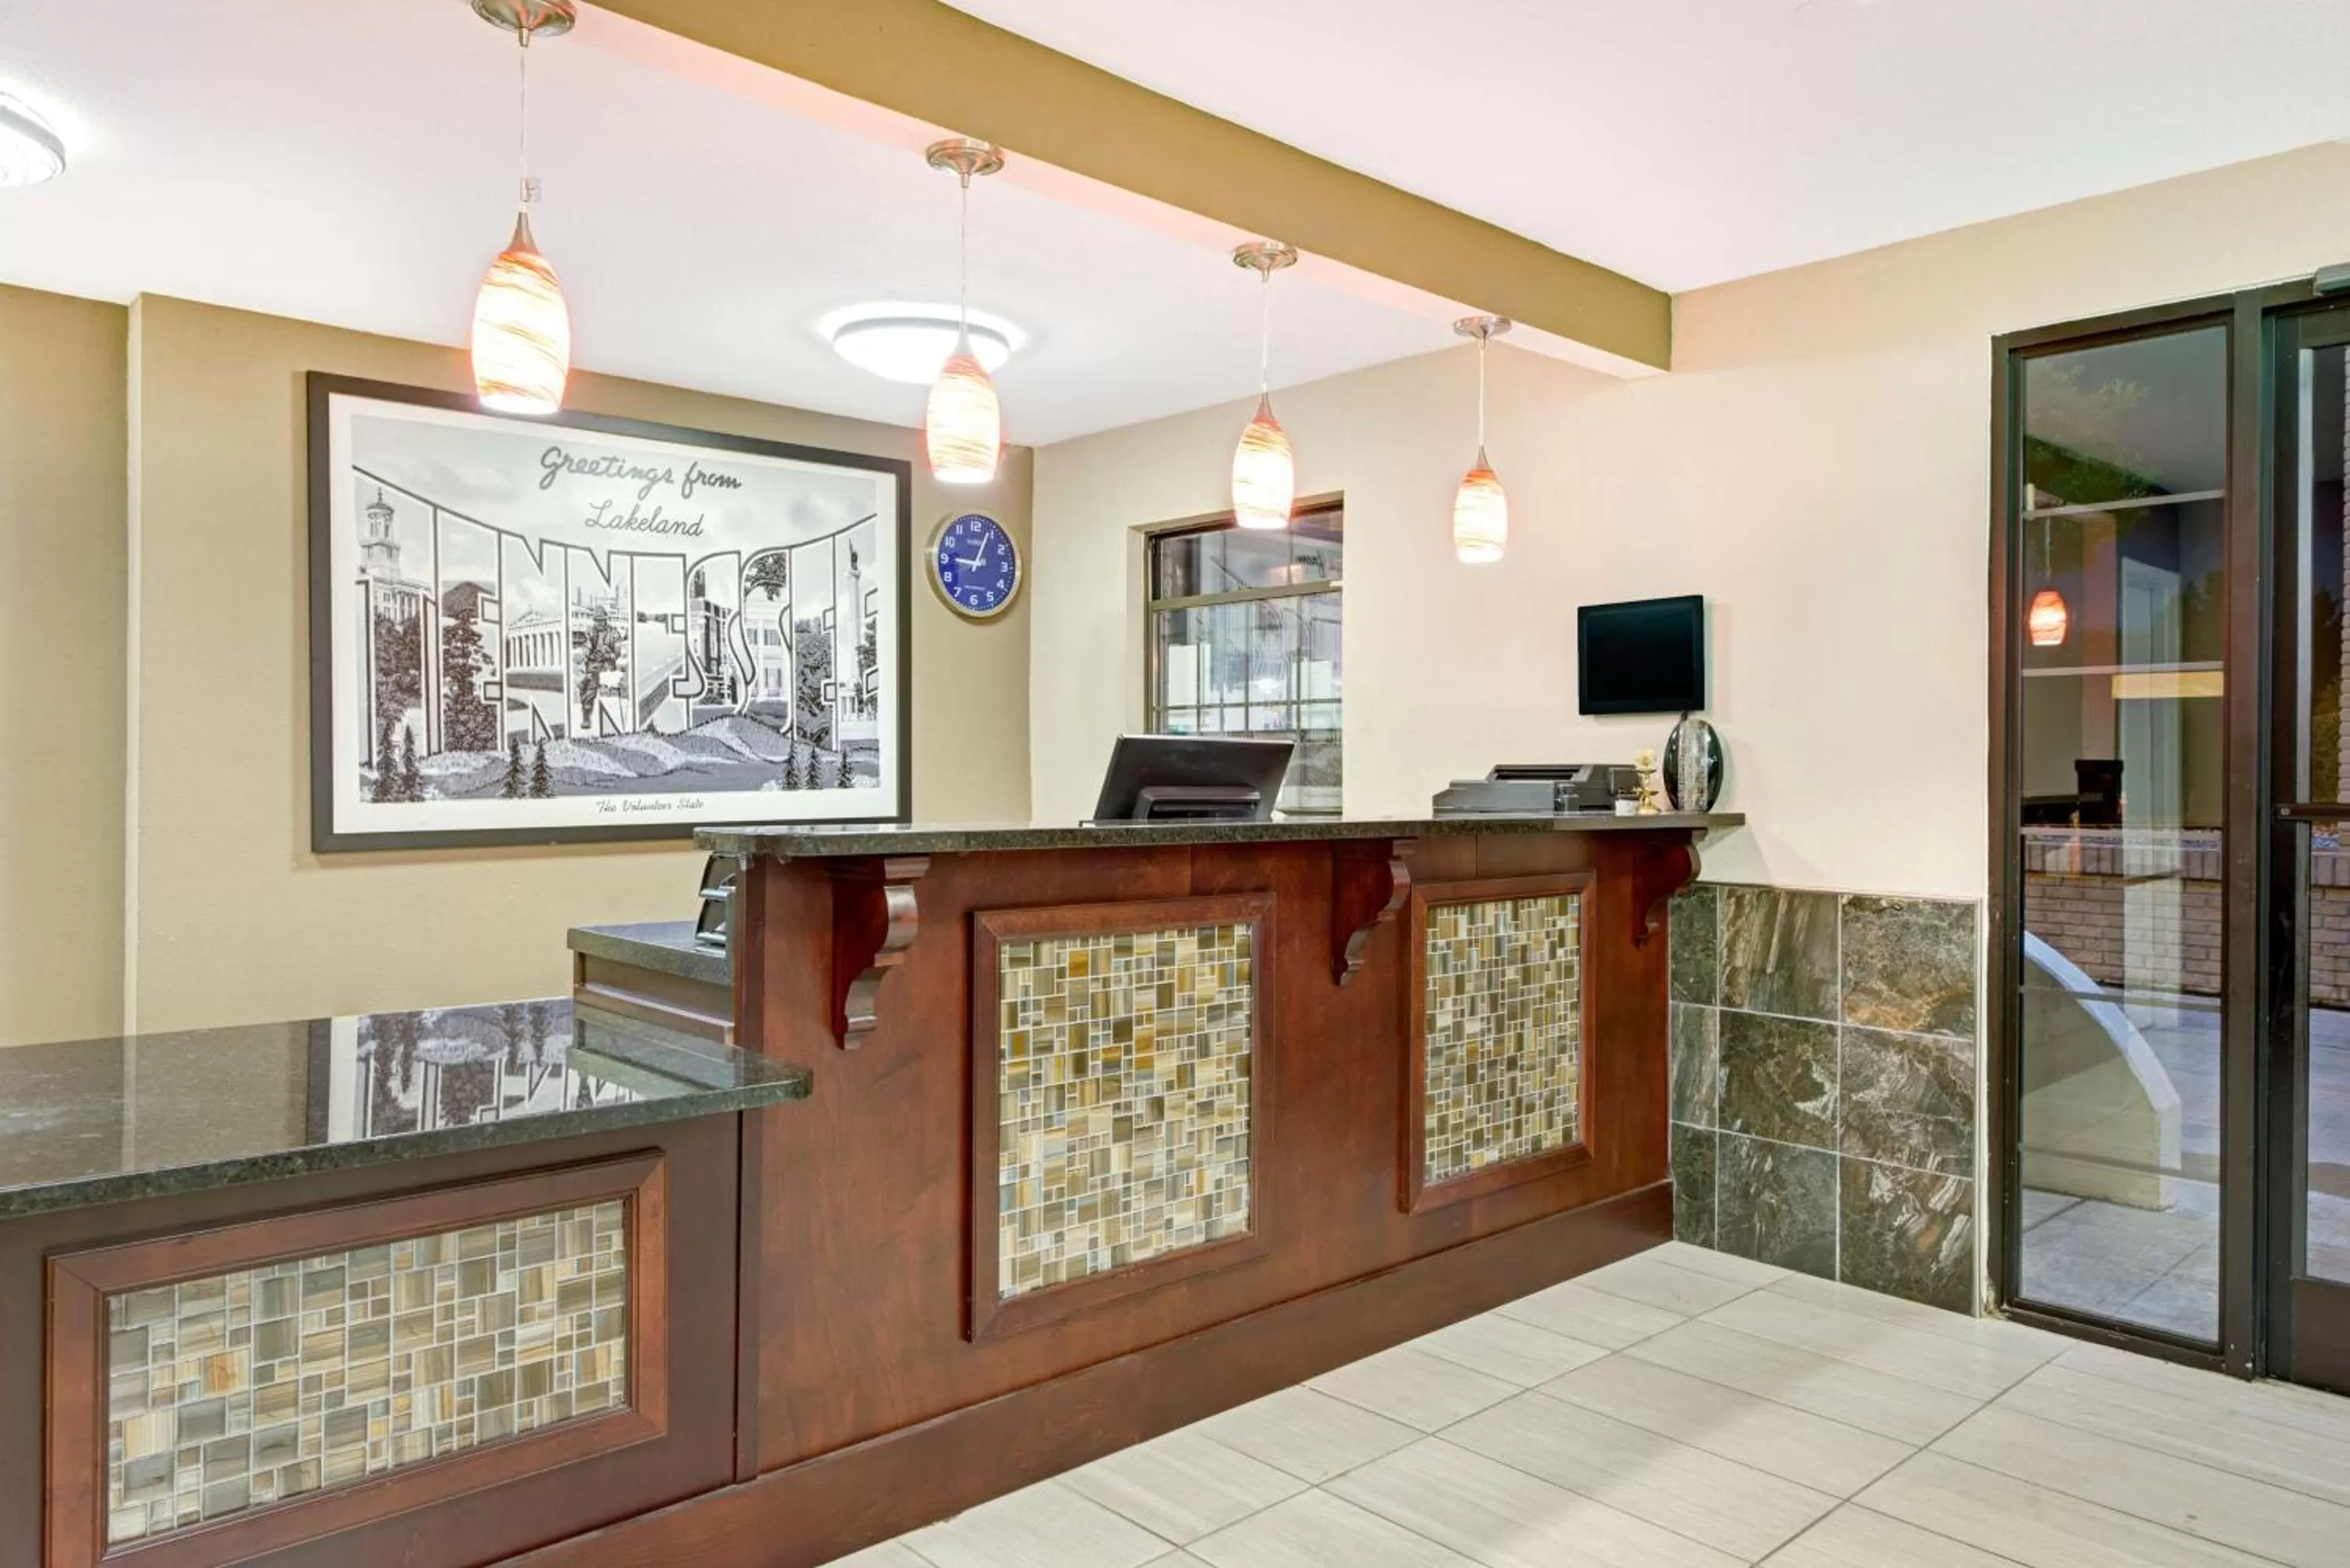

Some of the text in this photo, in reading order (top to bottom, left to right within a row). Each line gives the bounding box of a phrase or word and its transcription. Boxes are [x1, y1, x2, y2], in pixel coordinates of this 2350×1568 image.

[539, 446, 743, 501] Greetings from
[585, 499, 704, 537] Lakeland
[956, 524, 963, 535] 11
[971, 521, 982, 532] 12
[945, 537, 955, 547] 10
[997, 544, 1005, 555] 2
[940, 554, 949, 564] 9
[1000, 562, 1008, 573] 3
[944, 572, 952, 582] 8
[996, 579, 1004, 589] 4
[953, 587, 962, 597] 7
[986, 591, 994, 602] 5
[970, 594, 978, 605] 6
